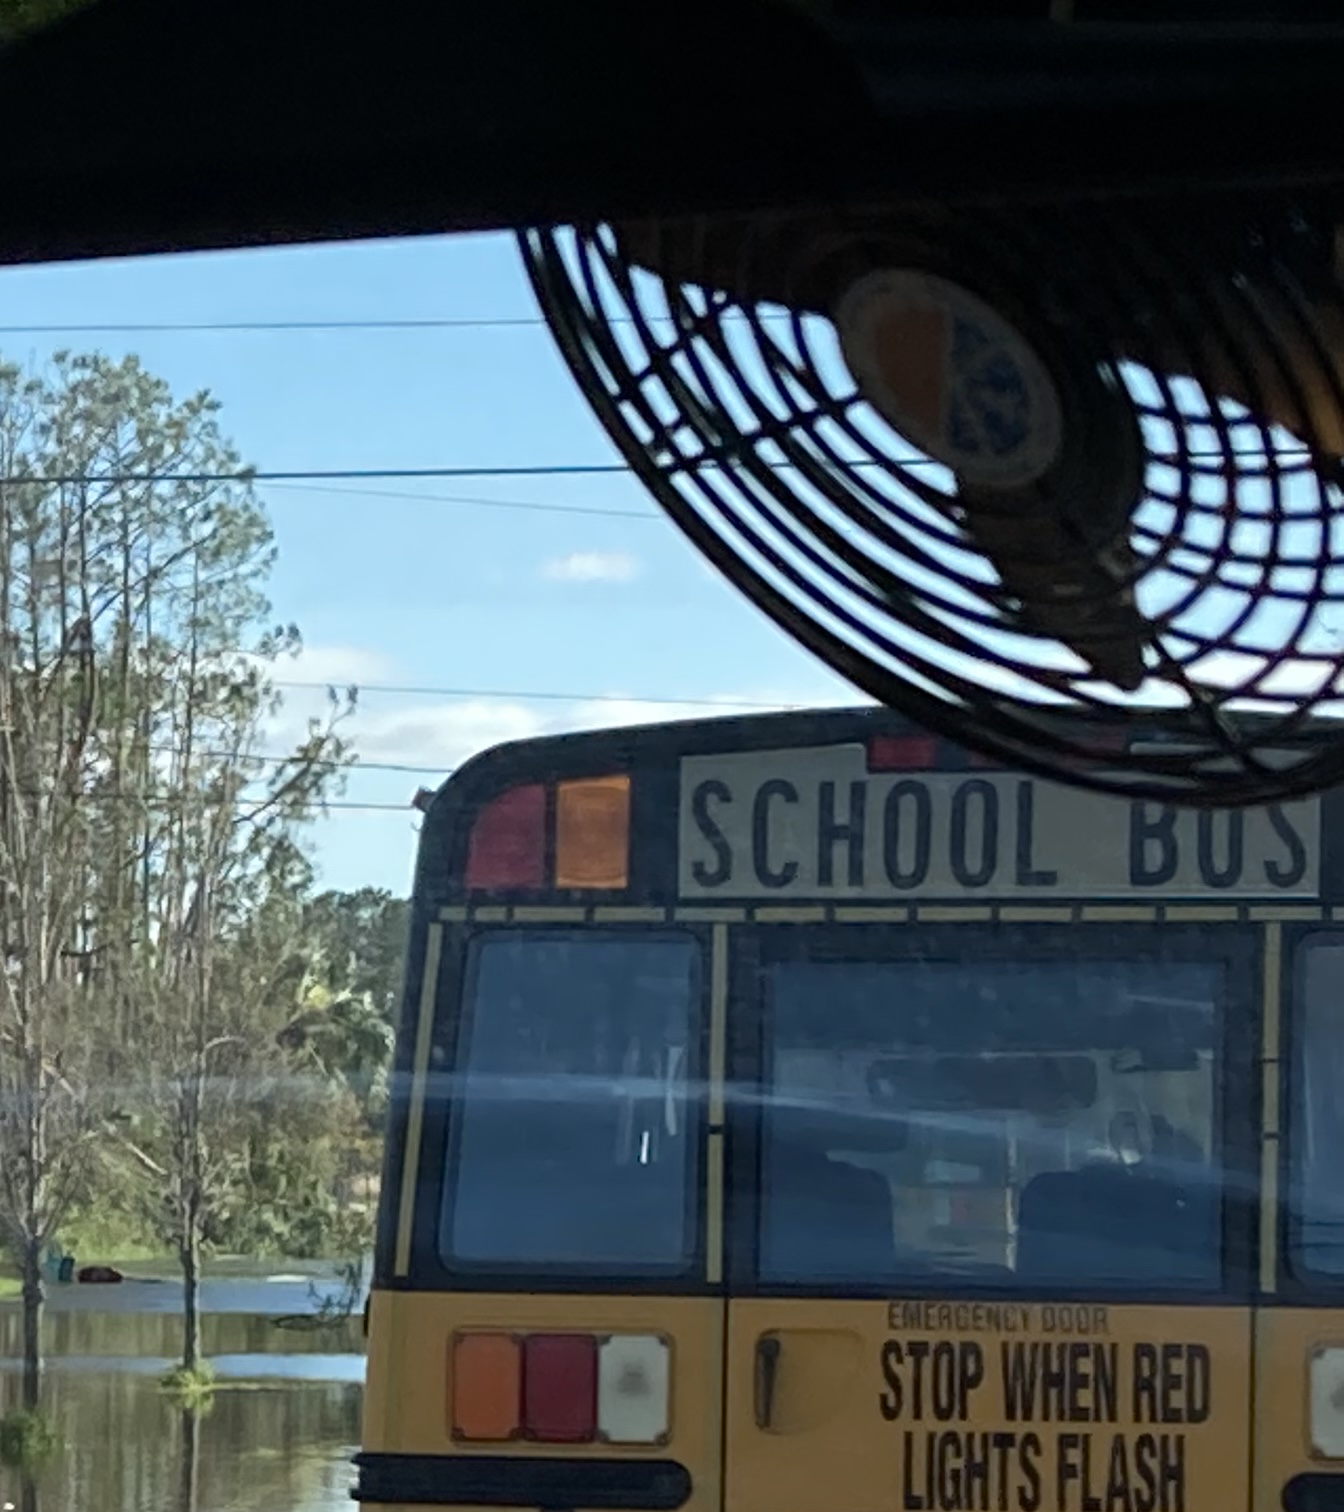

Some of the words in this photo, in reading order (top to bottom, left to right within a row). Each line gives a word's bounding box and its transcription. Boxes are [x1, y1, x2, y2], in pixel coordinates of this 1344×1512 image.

[690, 778, 1058, 889] SCHOOL
[1128, 798, 1308, 889] BUS
[887, 1302, 1032, 1333] EMERGENCY
[1042, 1306, 1111, 1335] DOOR
[878, 1339, 984, 1422] STOP
[1001, 1340, 1119, 1423] WHEN
[1131, 1342, 1211, 1425] RED
